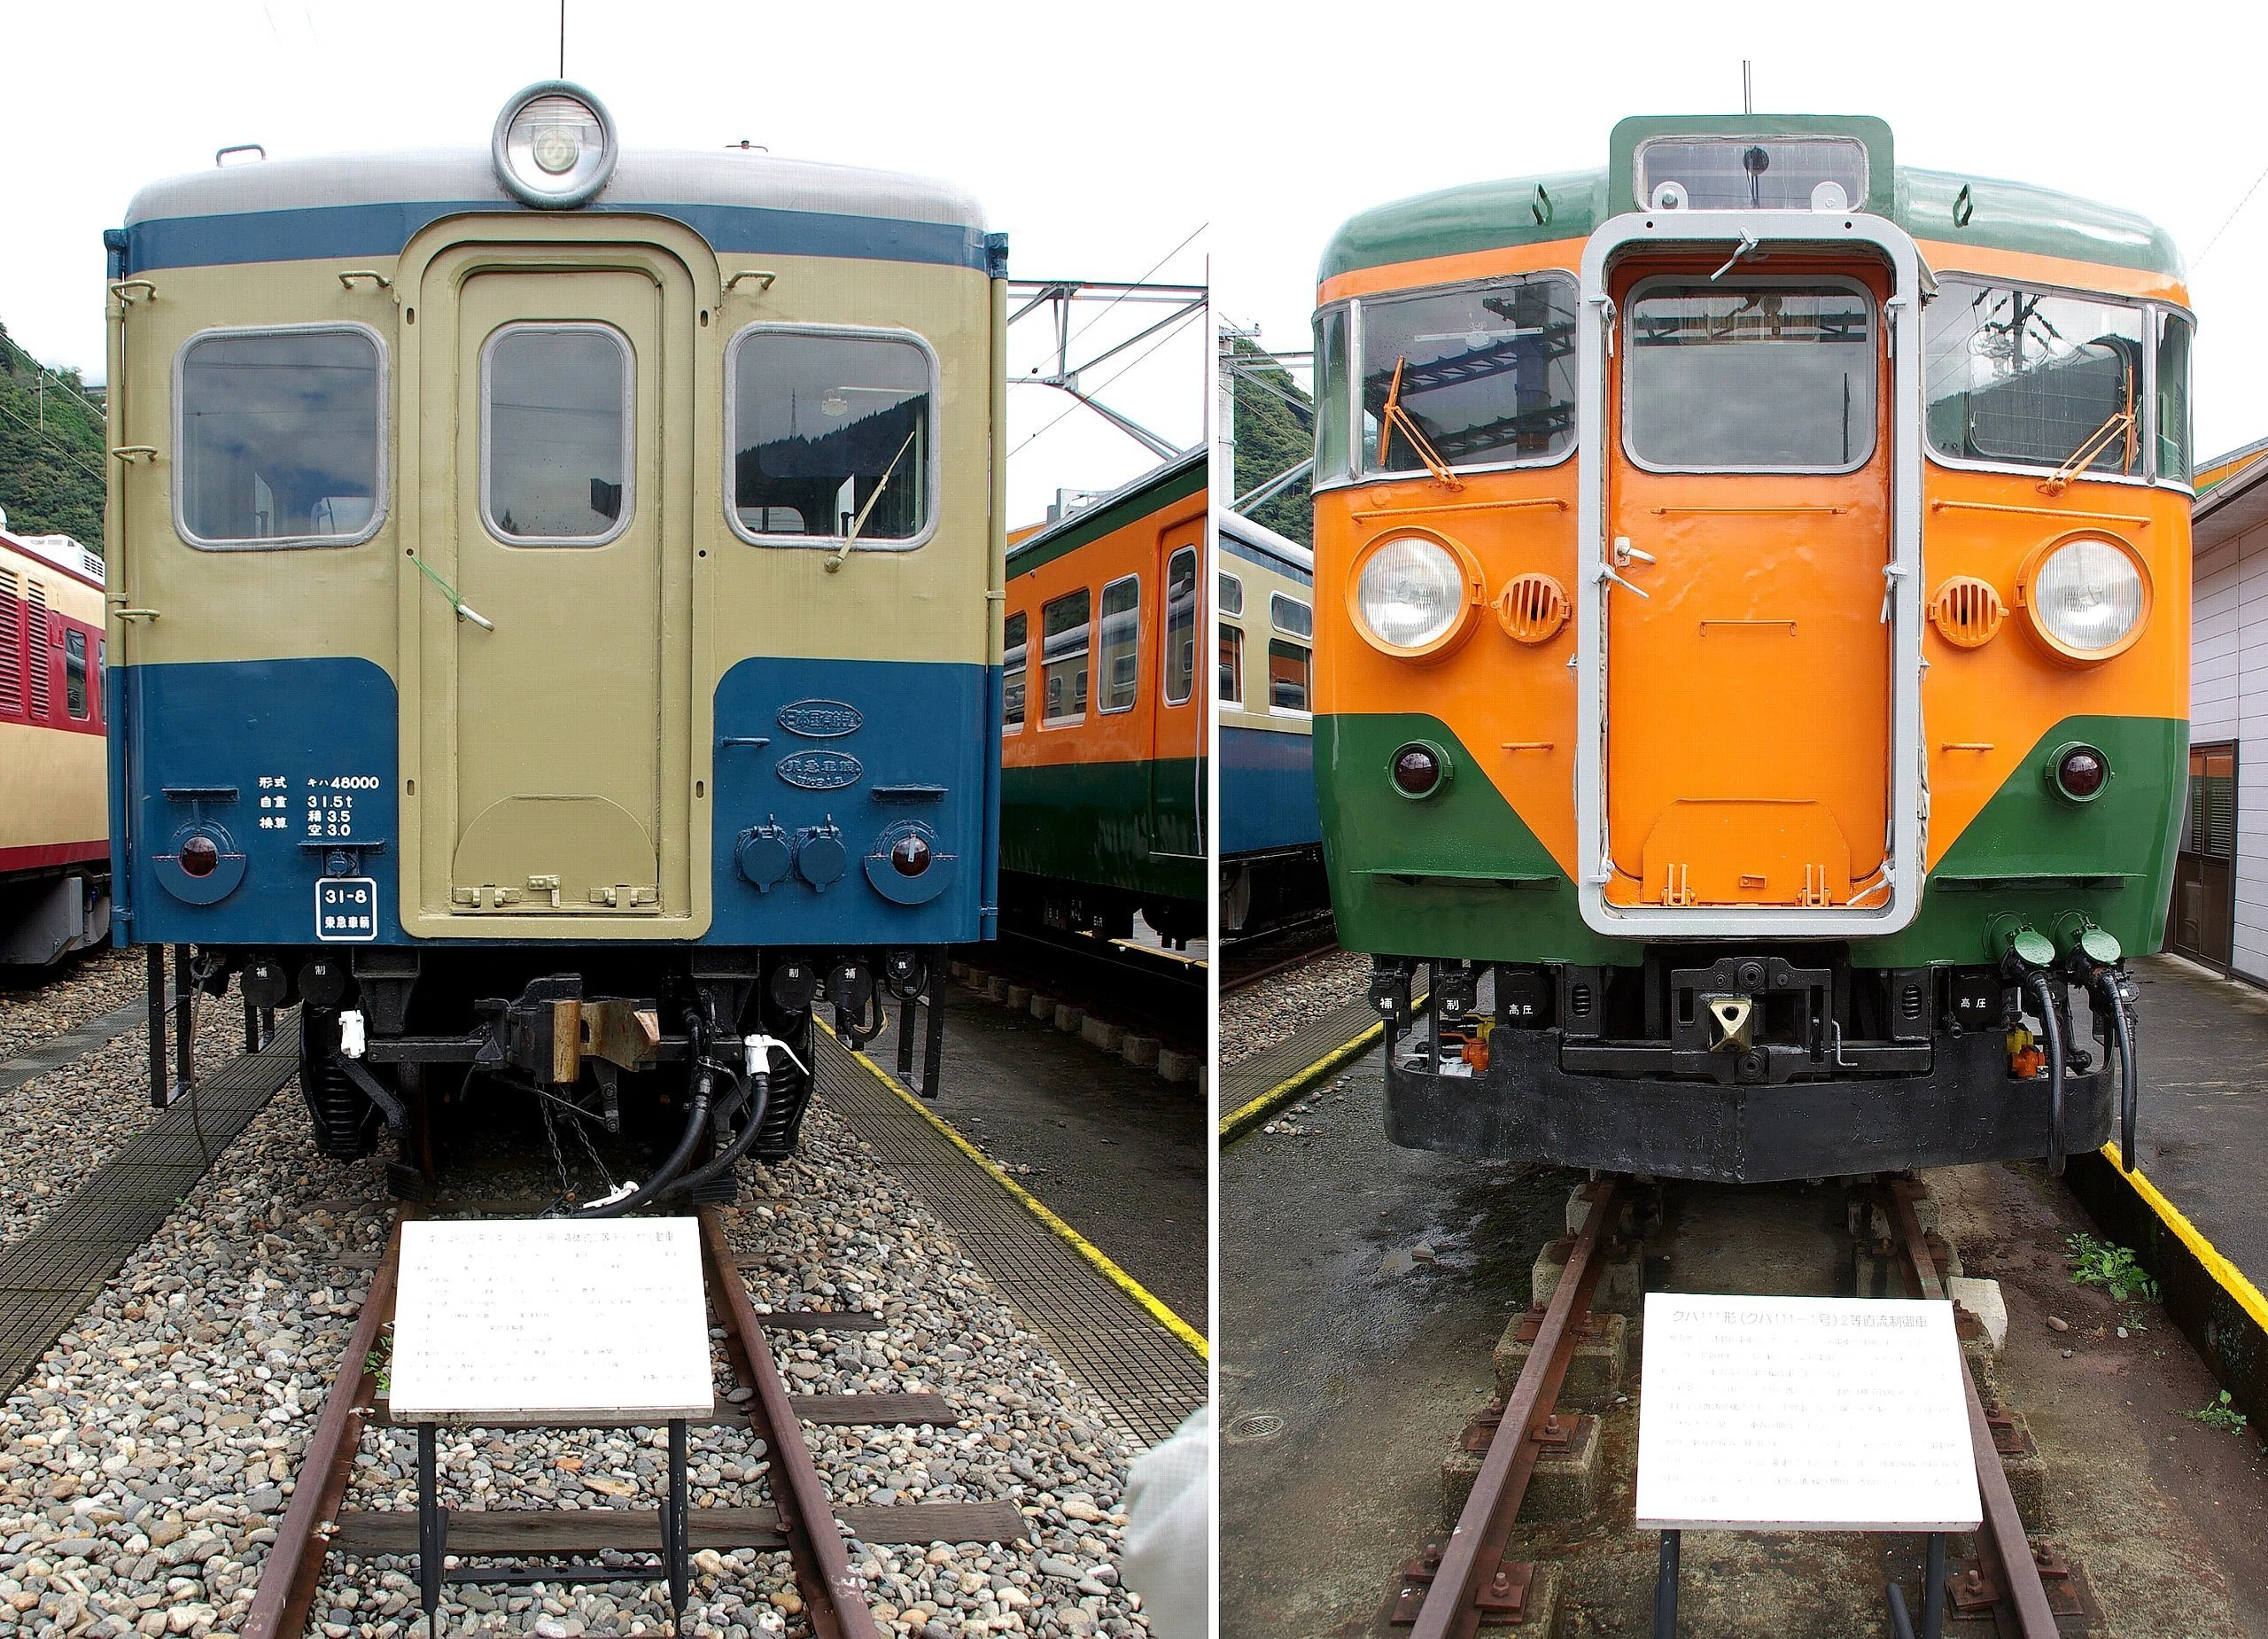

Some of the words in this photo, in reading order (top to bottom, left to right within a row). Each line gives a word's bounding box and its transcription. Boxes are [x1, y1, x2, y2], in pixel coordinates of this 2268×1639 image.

[259, 776, 287, 788] 形式
[307, 776, 379, 789] キハ48000
[260, 796, 287, 808] 自重
[259, 817, 288, 829] 換算
[327, 811, 351, 823] 3.5
[307, 824, 322, 836] 空
[327, 824, 351, 836] 3.0
[325, 889, 367, 904] 31-8
[844, 967, 857, 979] 補
[1379, 998, 1393, 1010] 補
[1446, 999, 1460, 1011] 制
[1961, 997, 1986, 1008] 高圧
[1509, 1004, 1534, 1015] 高圧
